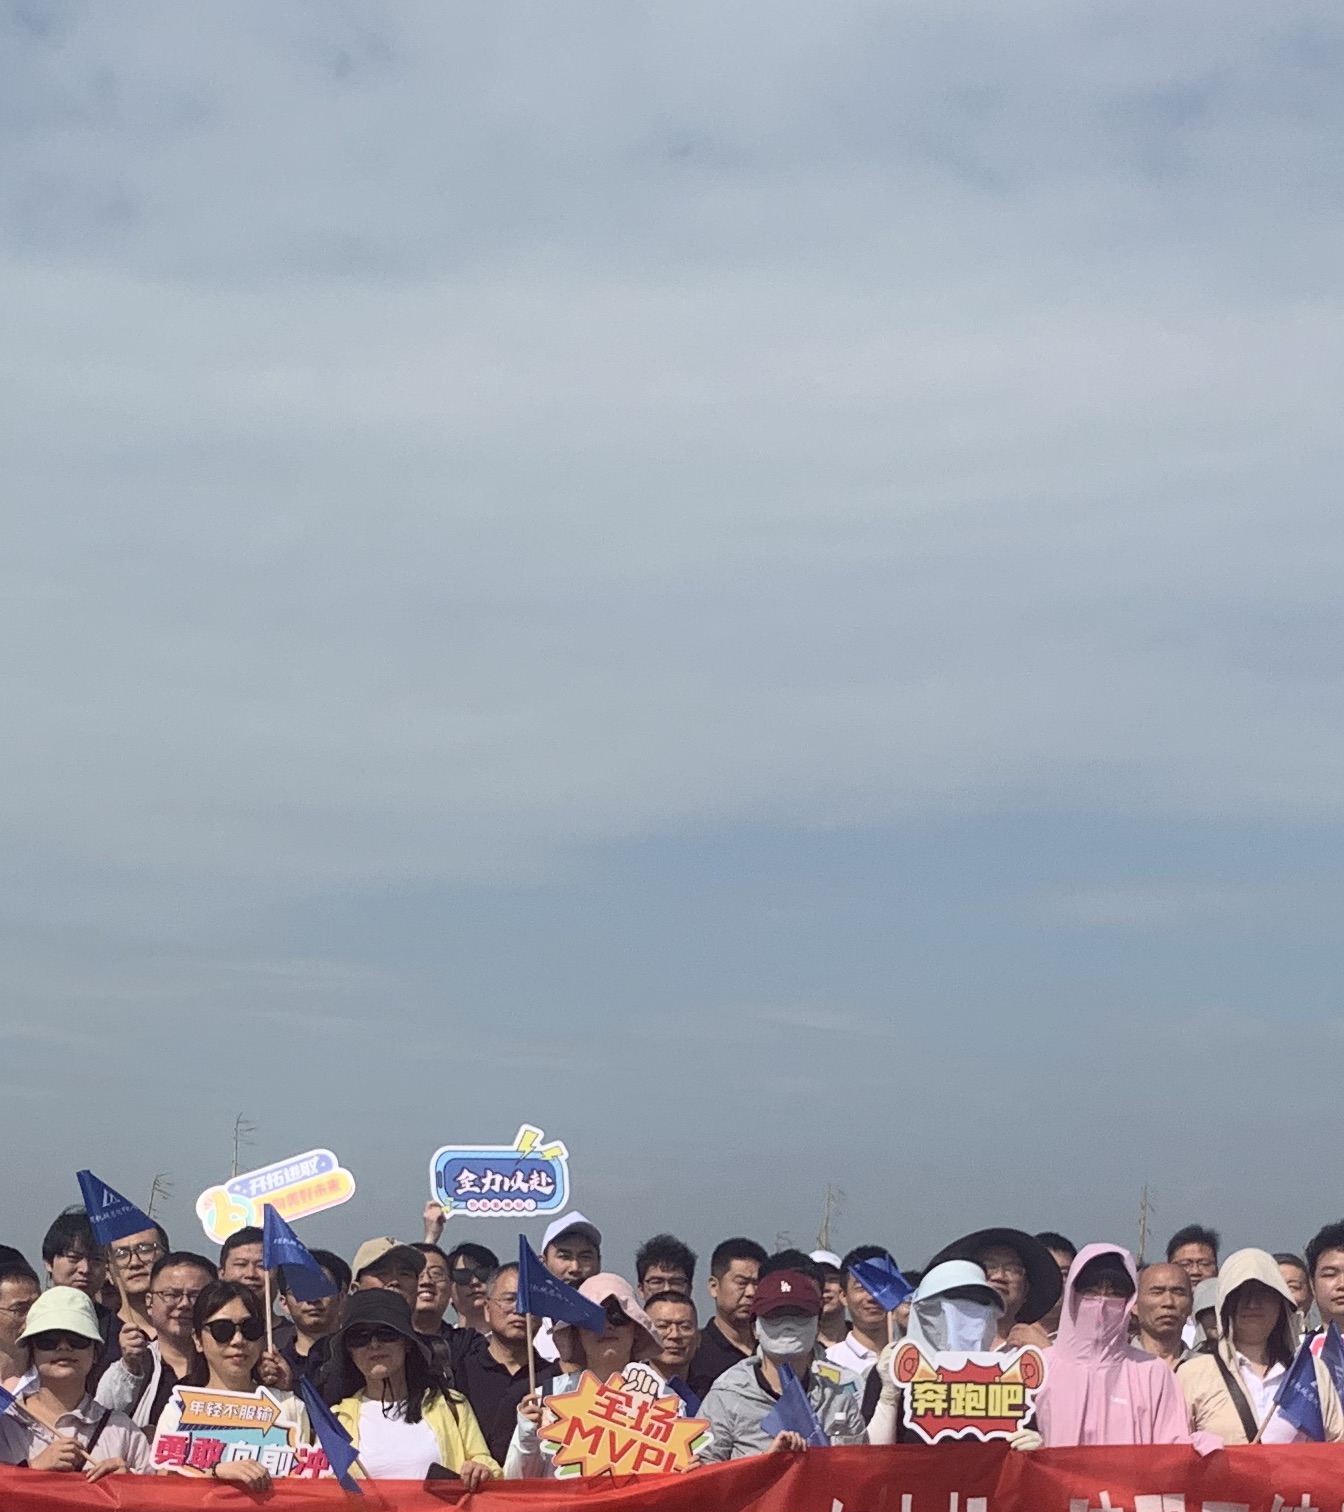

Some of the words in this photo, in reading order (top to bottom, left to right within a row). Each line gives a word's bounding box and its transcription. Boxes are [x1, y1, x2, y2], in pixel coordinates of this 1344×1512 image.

[248, 1155, 320, 1197] 开拓进取
[455, 1167, 555, 1195] 全力以赴
[256, 1179, 341, 1216] 向美好未来
[189, 1400, 273, 1422] 年轻不服输
[587, 1385, 678, 1443] 全场
[912, 1382, 1024, 1417] 奔跑吧
[154, 1434, 331, 1479] 勇敢向前冲
